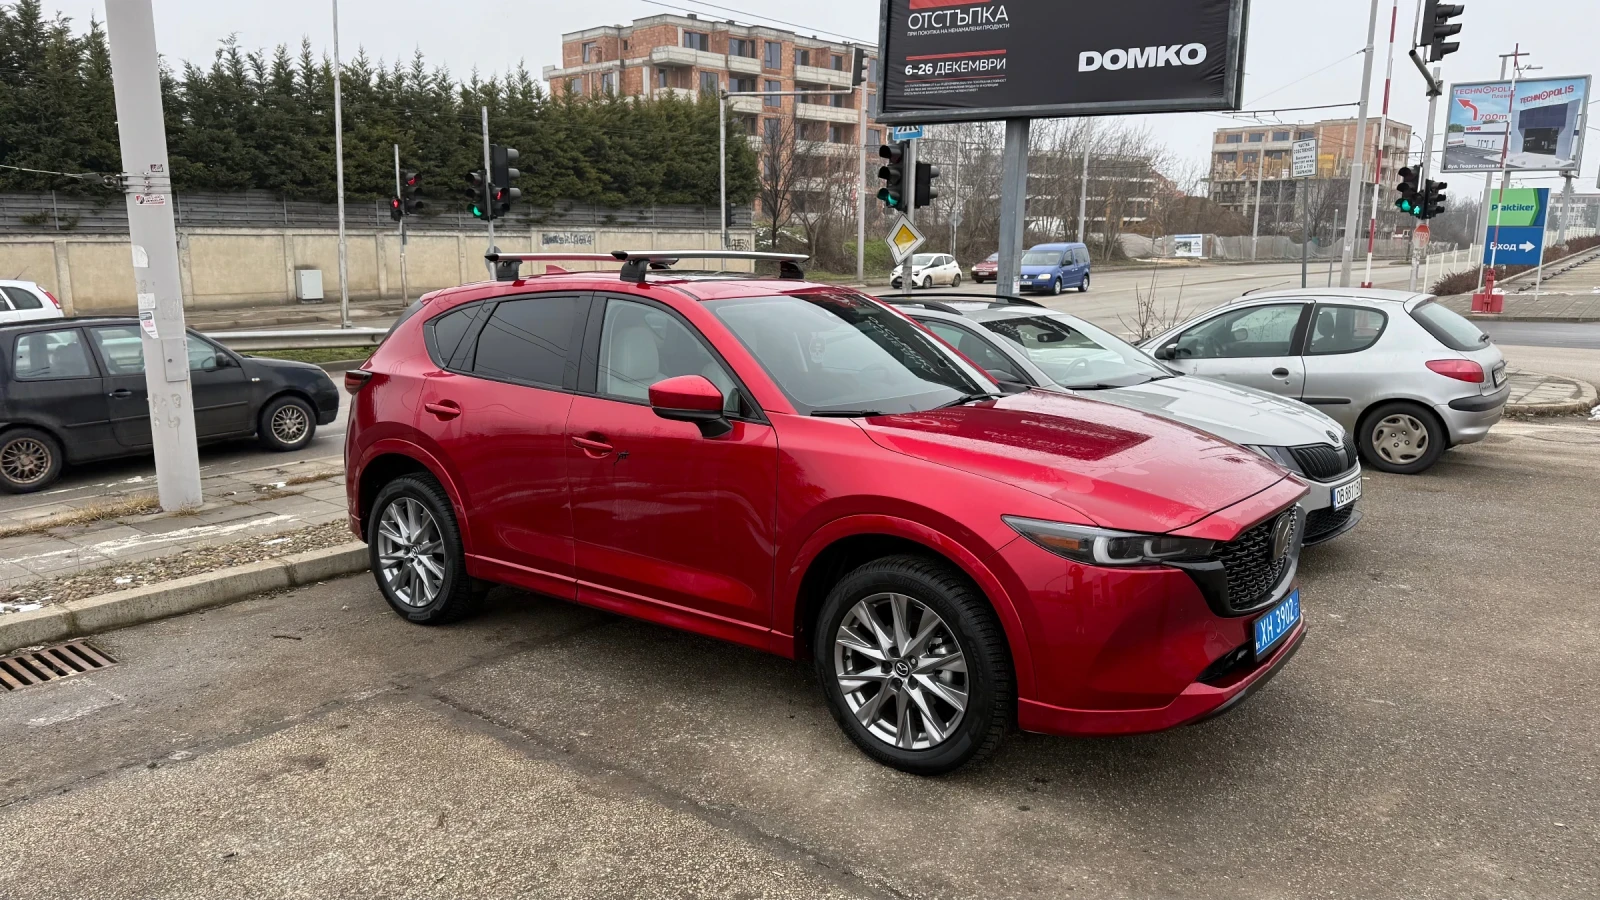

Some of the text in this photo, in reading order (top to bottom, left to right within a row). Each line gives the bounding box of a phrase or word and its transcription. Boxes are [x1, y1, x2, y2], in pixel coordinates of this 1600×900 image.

[907, 4, 1009, 30] ОТСТЪПКА
[983, 23, 1010, 31] ПРОДУКТИ
[904, 57, 1006, 76] 6-26 ДЕКЕМВРИ
[1078, 42, 1207, 72] DOMKO
[1519, 84, 1575, 104] TECHNOPOLIS
[1491, 203, 1535, 212] Paktiker
[1275, 598, 1295, 634] 3902
